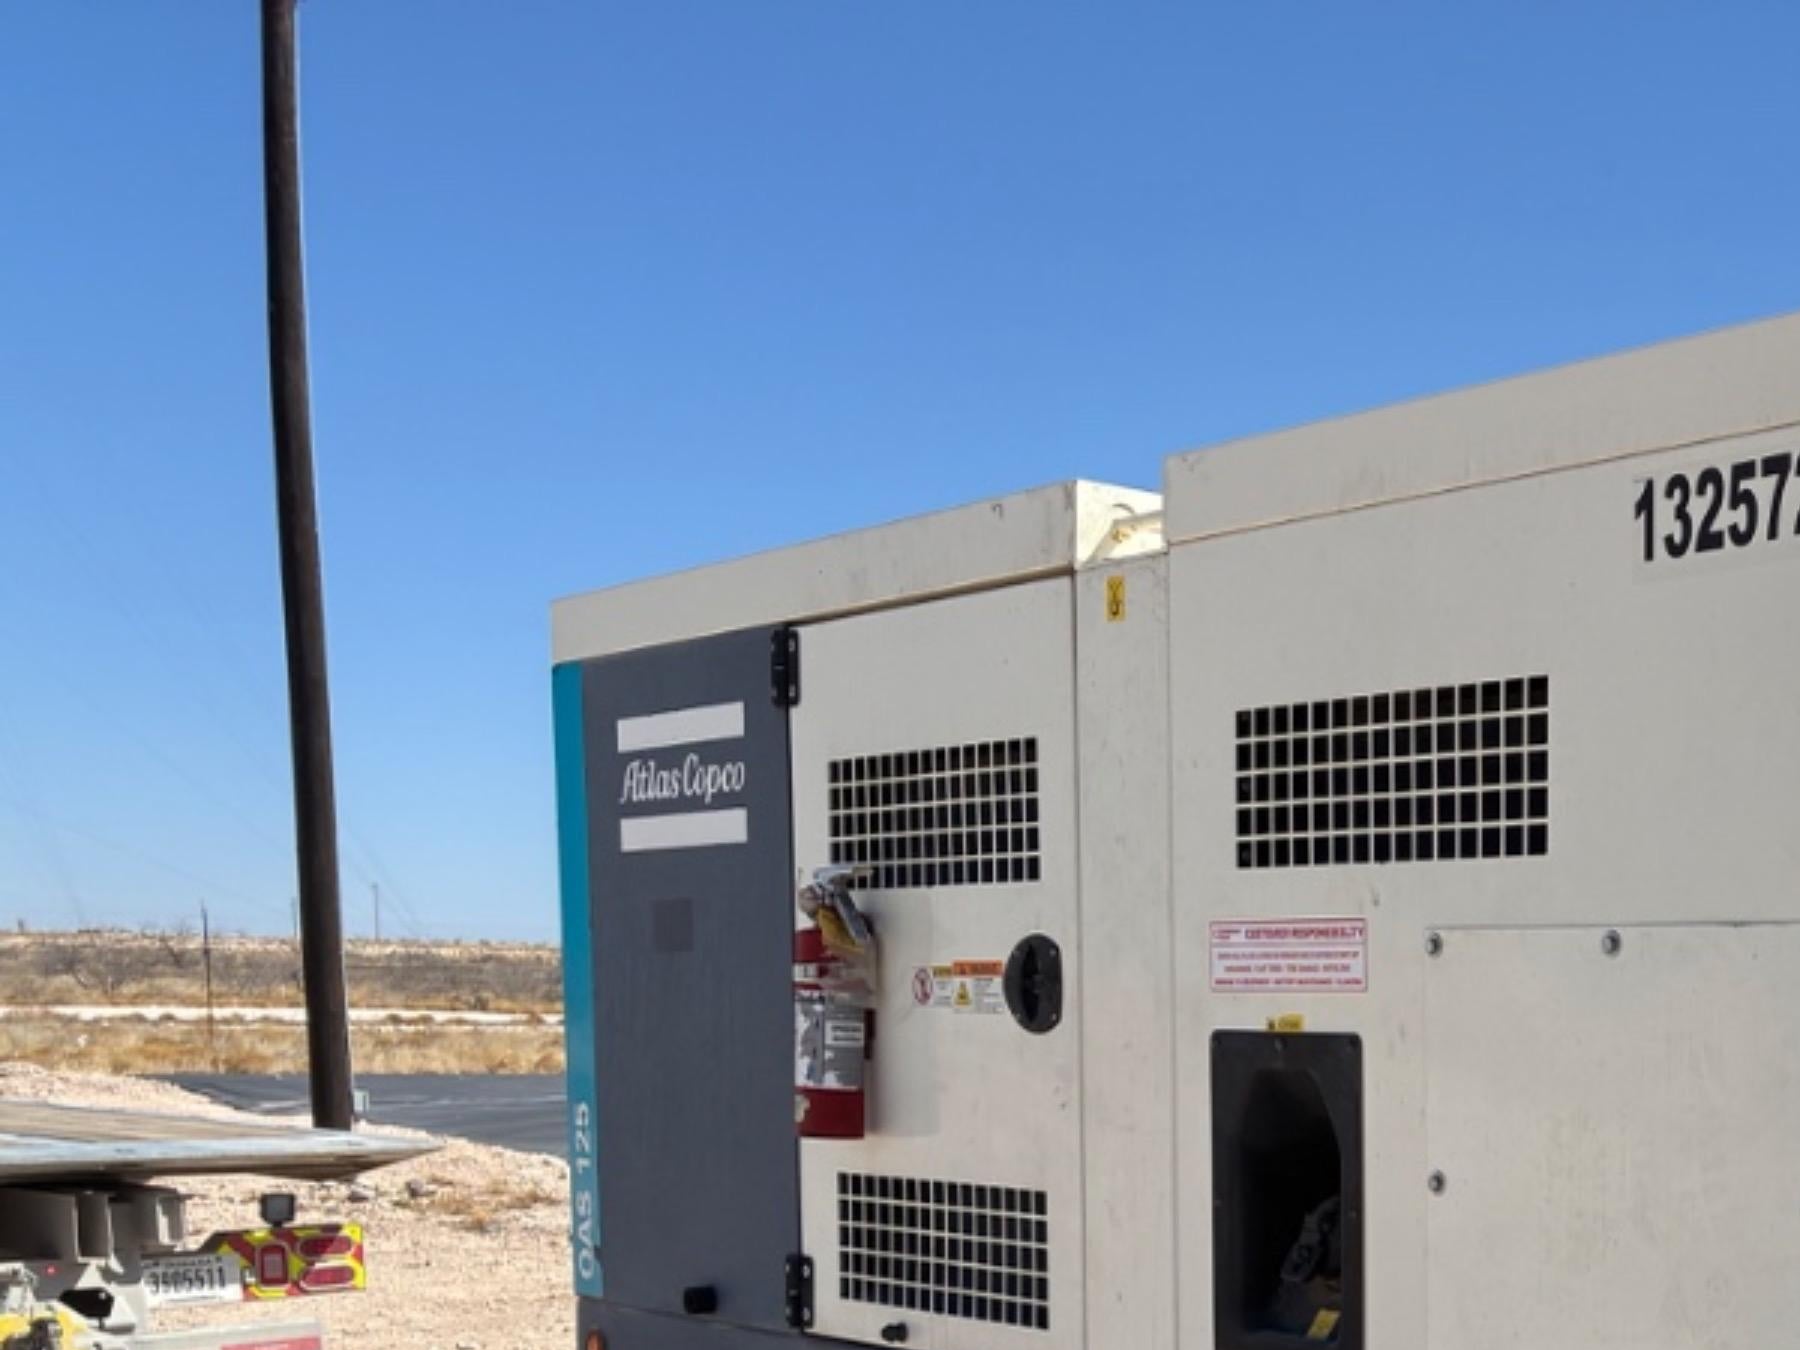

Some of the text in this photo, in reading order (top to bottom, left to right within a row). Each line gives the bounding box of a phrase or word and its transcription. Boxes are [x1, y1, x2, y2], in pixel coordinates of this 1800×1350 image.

[619, 752, 745, 805] Atlas Copco
[575, 1102, 591, 1176] 125
